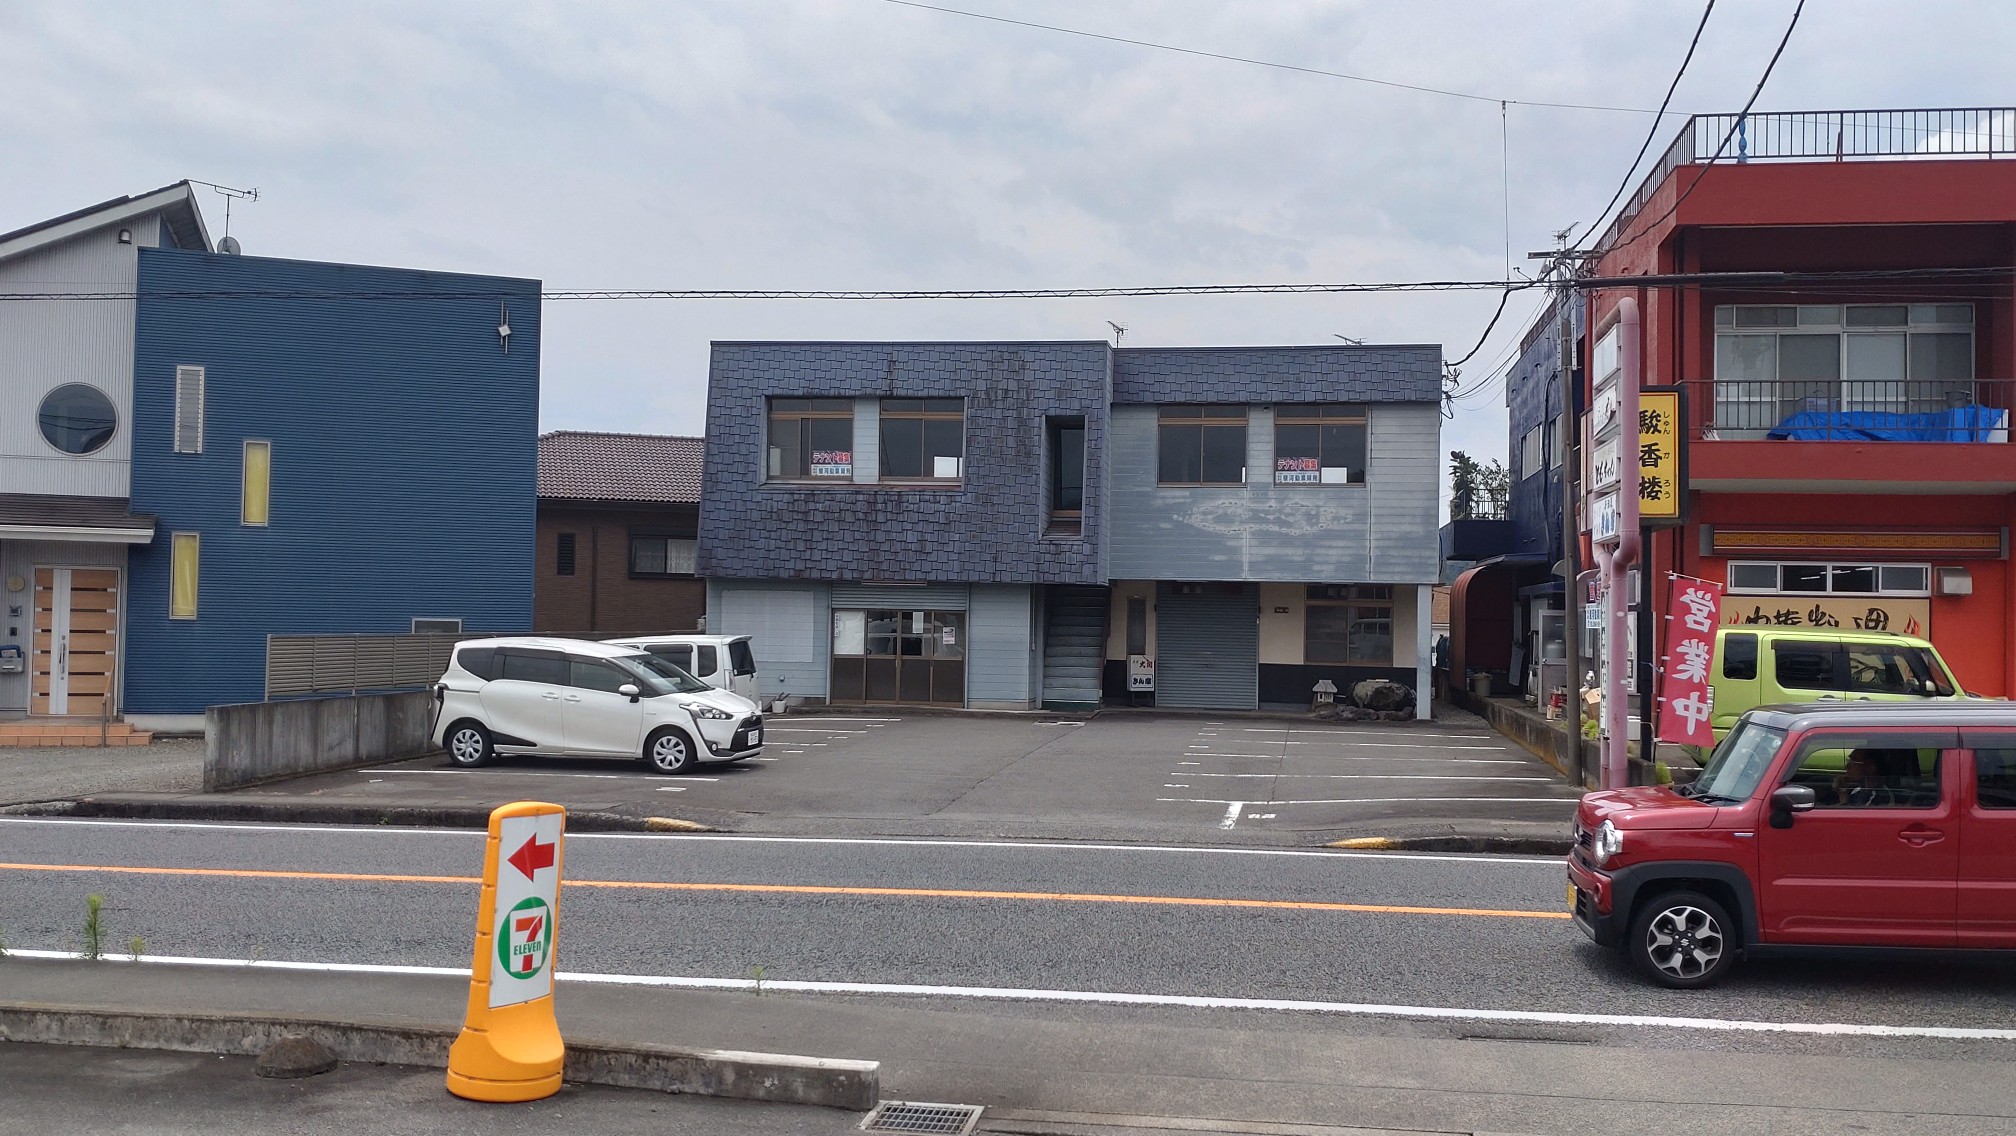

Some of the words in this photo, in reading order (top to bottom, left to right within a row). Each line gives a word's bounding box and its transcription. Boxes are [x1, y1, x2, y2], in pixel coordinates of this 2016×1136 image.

[1663, 411, 1671, 435] しゅん
[1663, 480, 1671, 499] ろう
[1672, 587, 1716, 736] 営業中
[515, 914, 543, 973] 7
